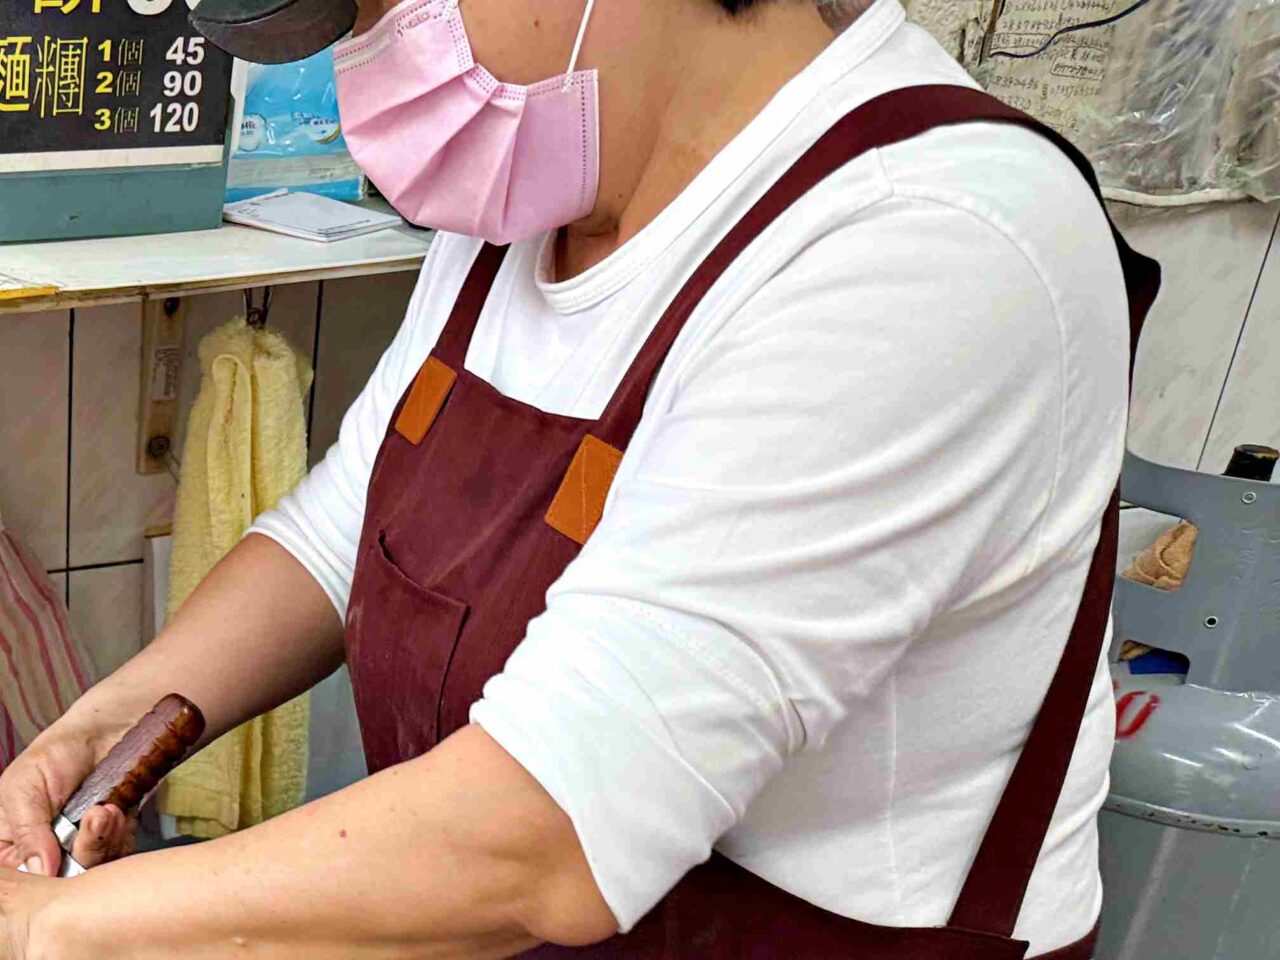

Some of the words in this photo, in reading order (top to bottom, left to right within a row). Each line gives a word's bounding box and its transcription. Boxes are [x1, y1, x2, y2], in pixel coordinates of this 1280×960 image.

[166, 36, 205, 65] 45
[163, 70, 203, 97] 90
[149, 102, 199, 133] 120
